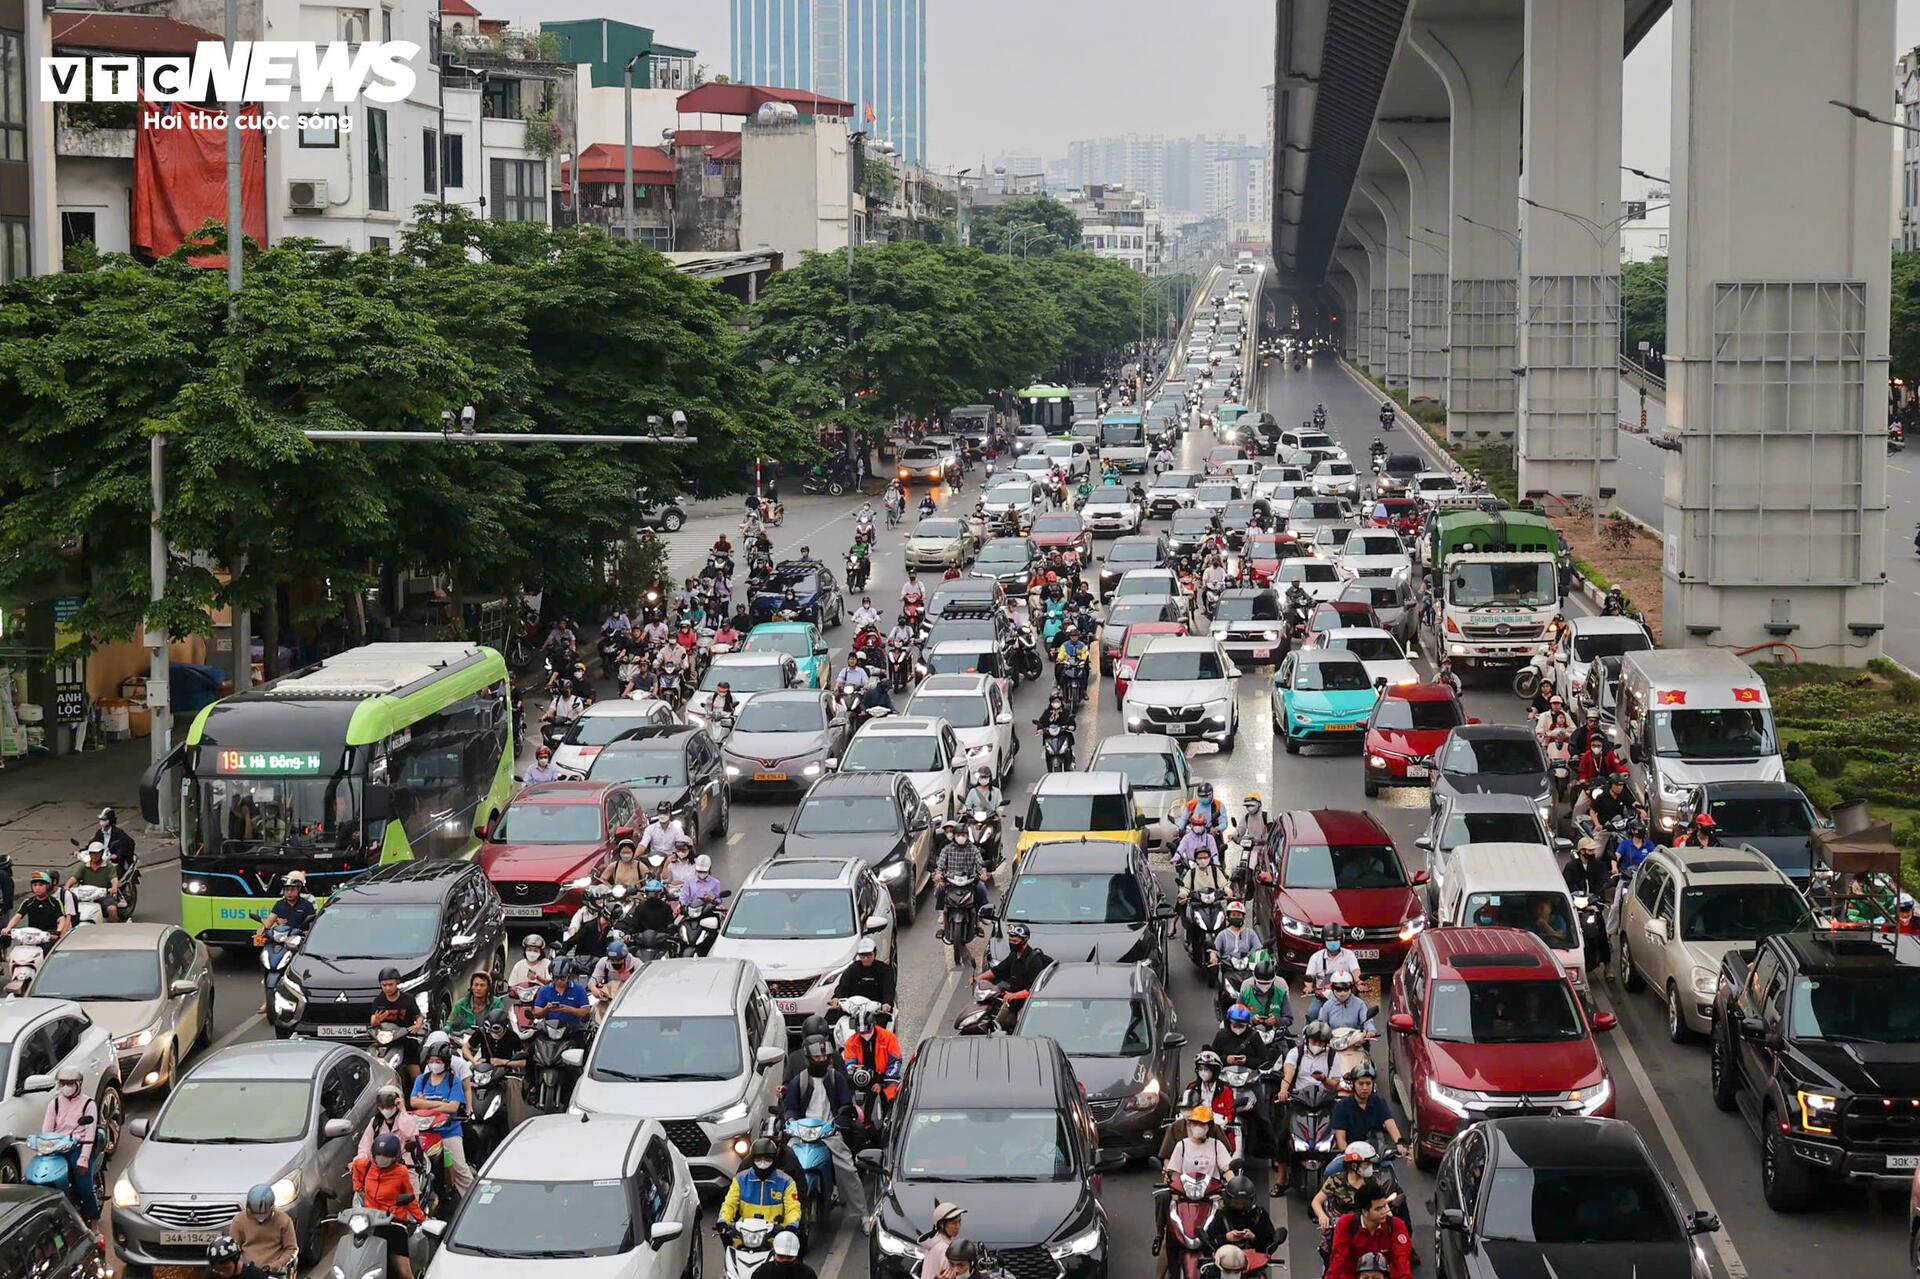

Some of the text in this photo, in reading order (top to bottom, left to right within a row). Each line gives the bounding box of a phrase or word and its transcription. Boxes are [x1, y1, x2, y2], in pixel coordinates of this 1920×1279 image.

[57, 693, 82, 703] ANH
[250, 754, 266, 769] Hà
[221, 908, 246, 919] BUS
